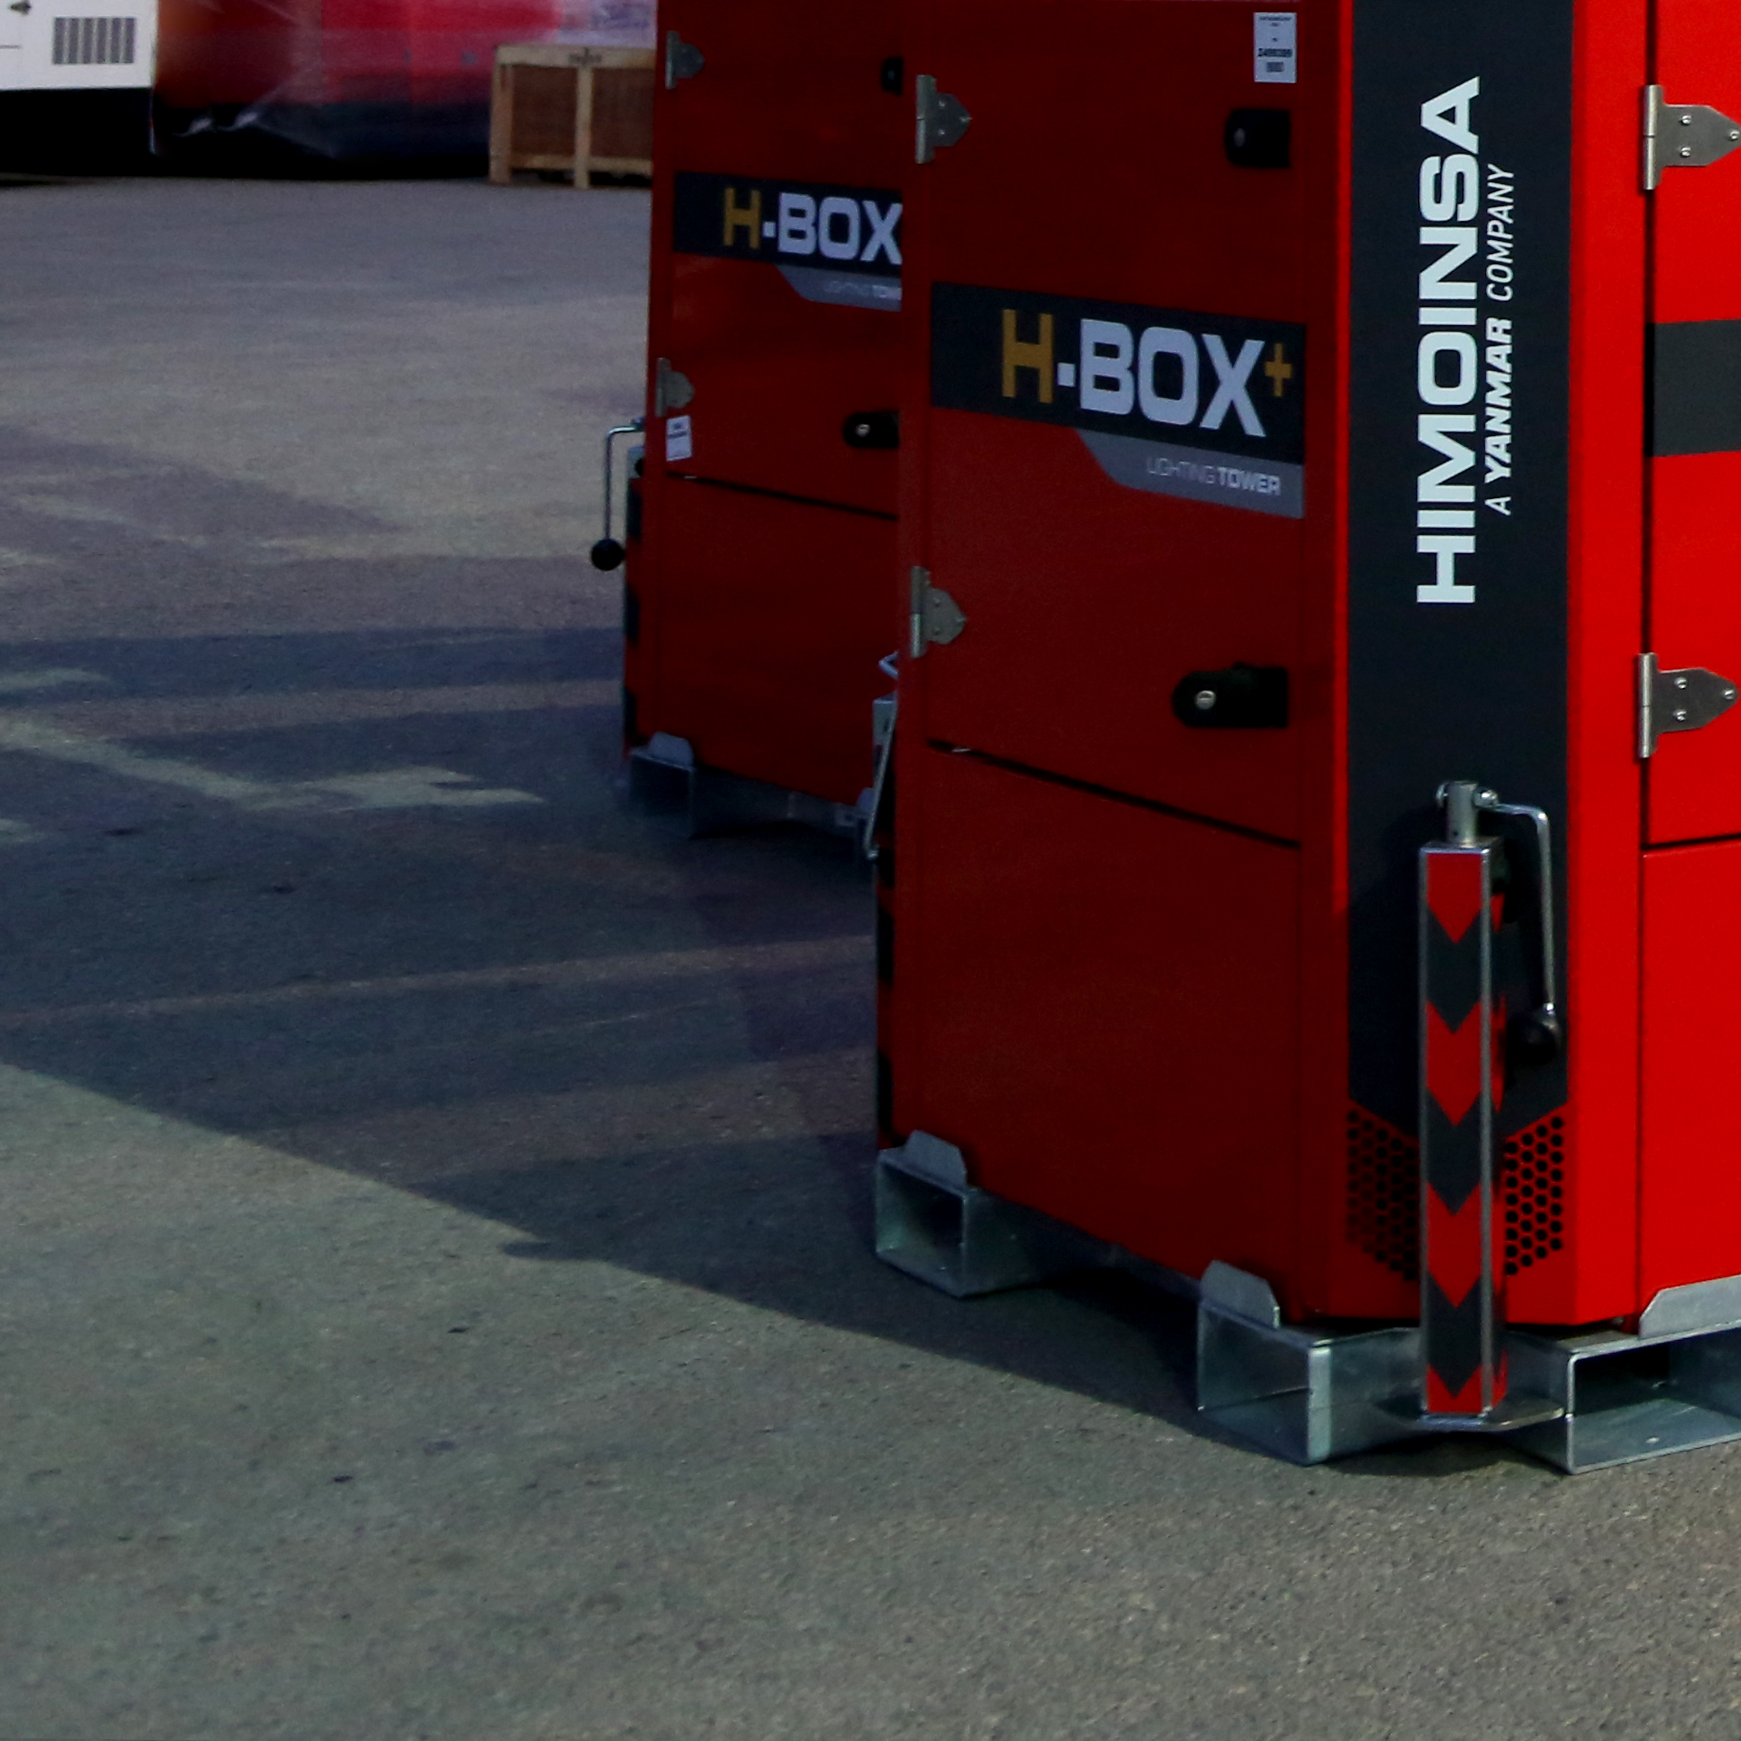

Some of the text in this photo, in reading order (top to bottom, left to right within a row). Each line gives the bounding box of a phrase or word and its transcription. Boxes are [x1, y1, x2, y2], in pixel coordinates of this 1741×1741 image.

[1002, 308, 1293, 438] H-BOX+
[1416, 75, 1481, 605] HIMOINSA
[1484, 163, 1515, 516] A YANMAR COMPANY
[1147, 457, 1282, 497] LIGHTING TOWER
